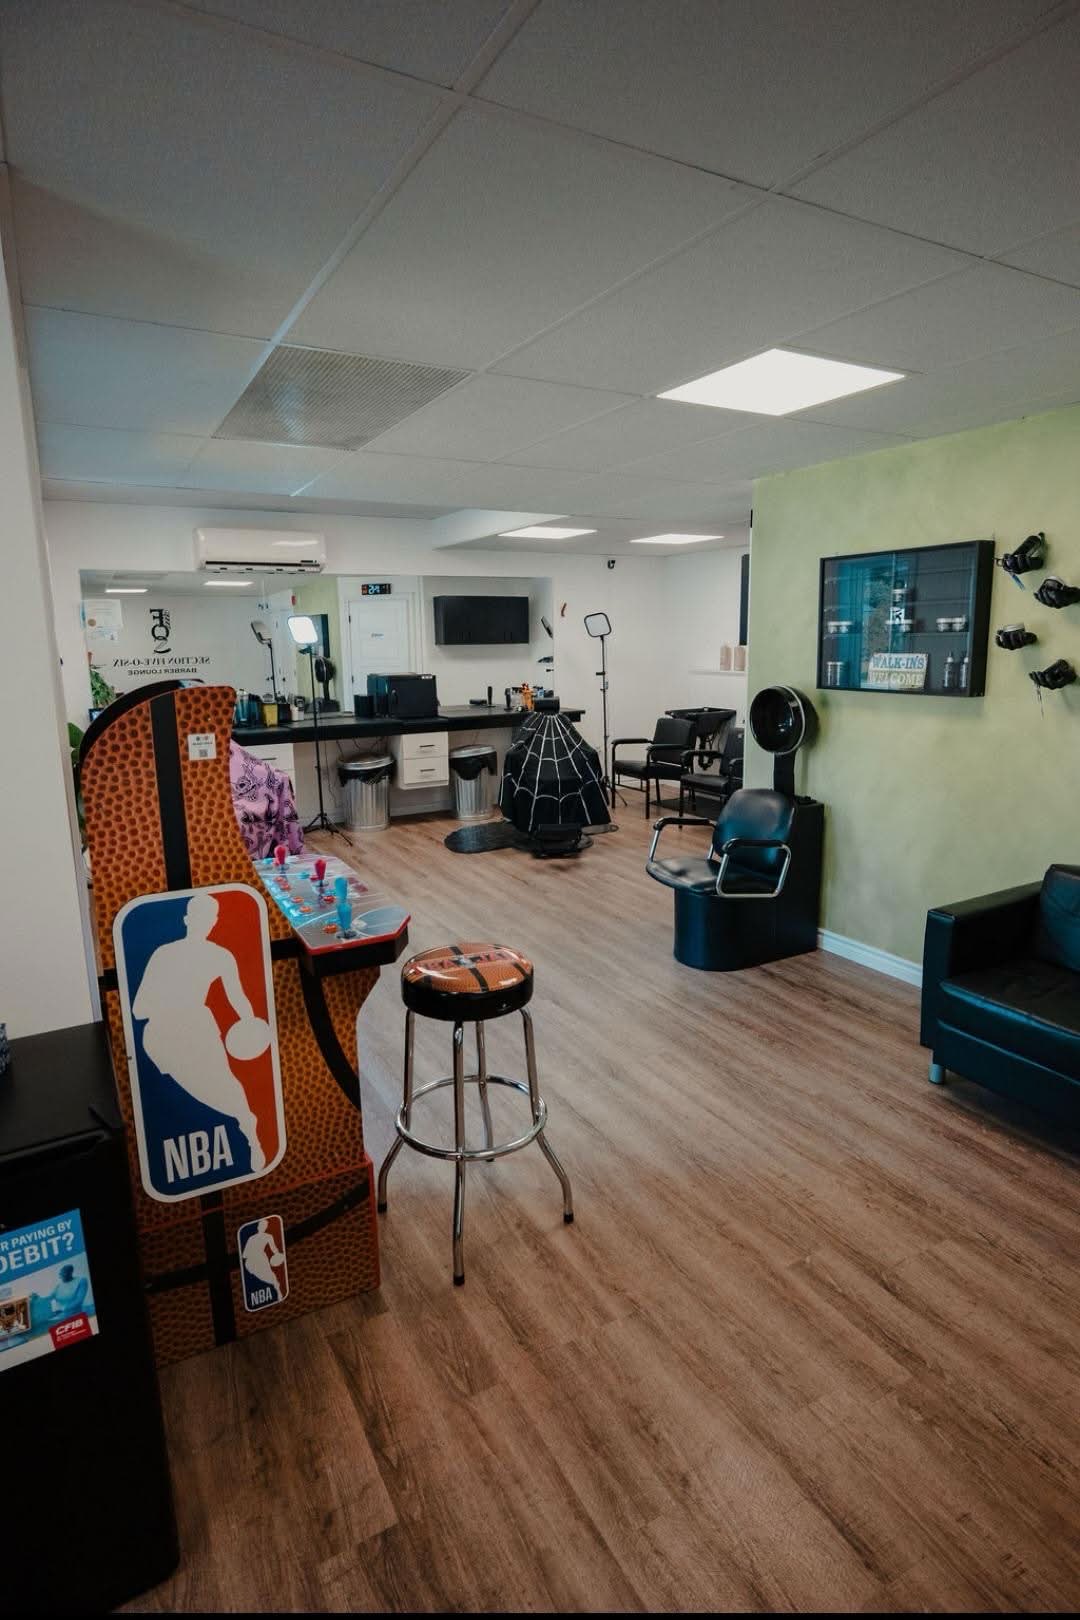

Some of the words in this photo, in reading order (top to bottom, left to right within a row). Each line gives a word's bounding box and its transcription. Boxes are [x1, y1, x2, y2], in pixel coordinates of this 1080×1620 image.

[163, 1124, 234, 1184] NBA
[11, 1225, 55, 1248] PAYING
[57, 1219, 72, 1233] BY
[251, 1287, 273, 1306] NBA
